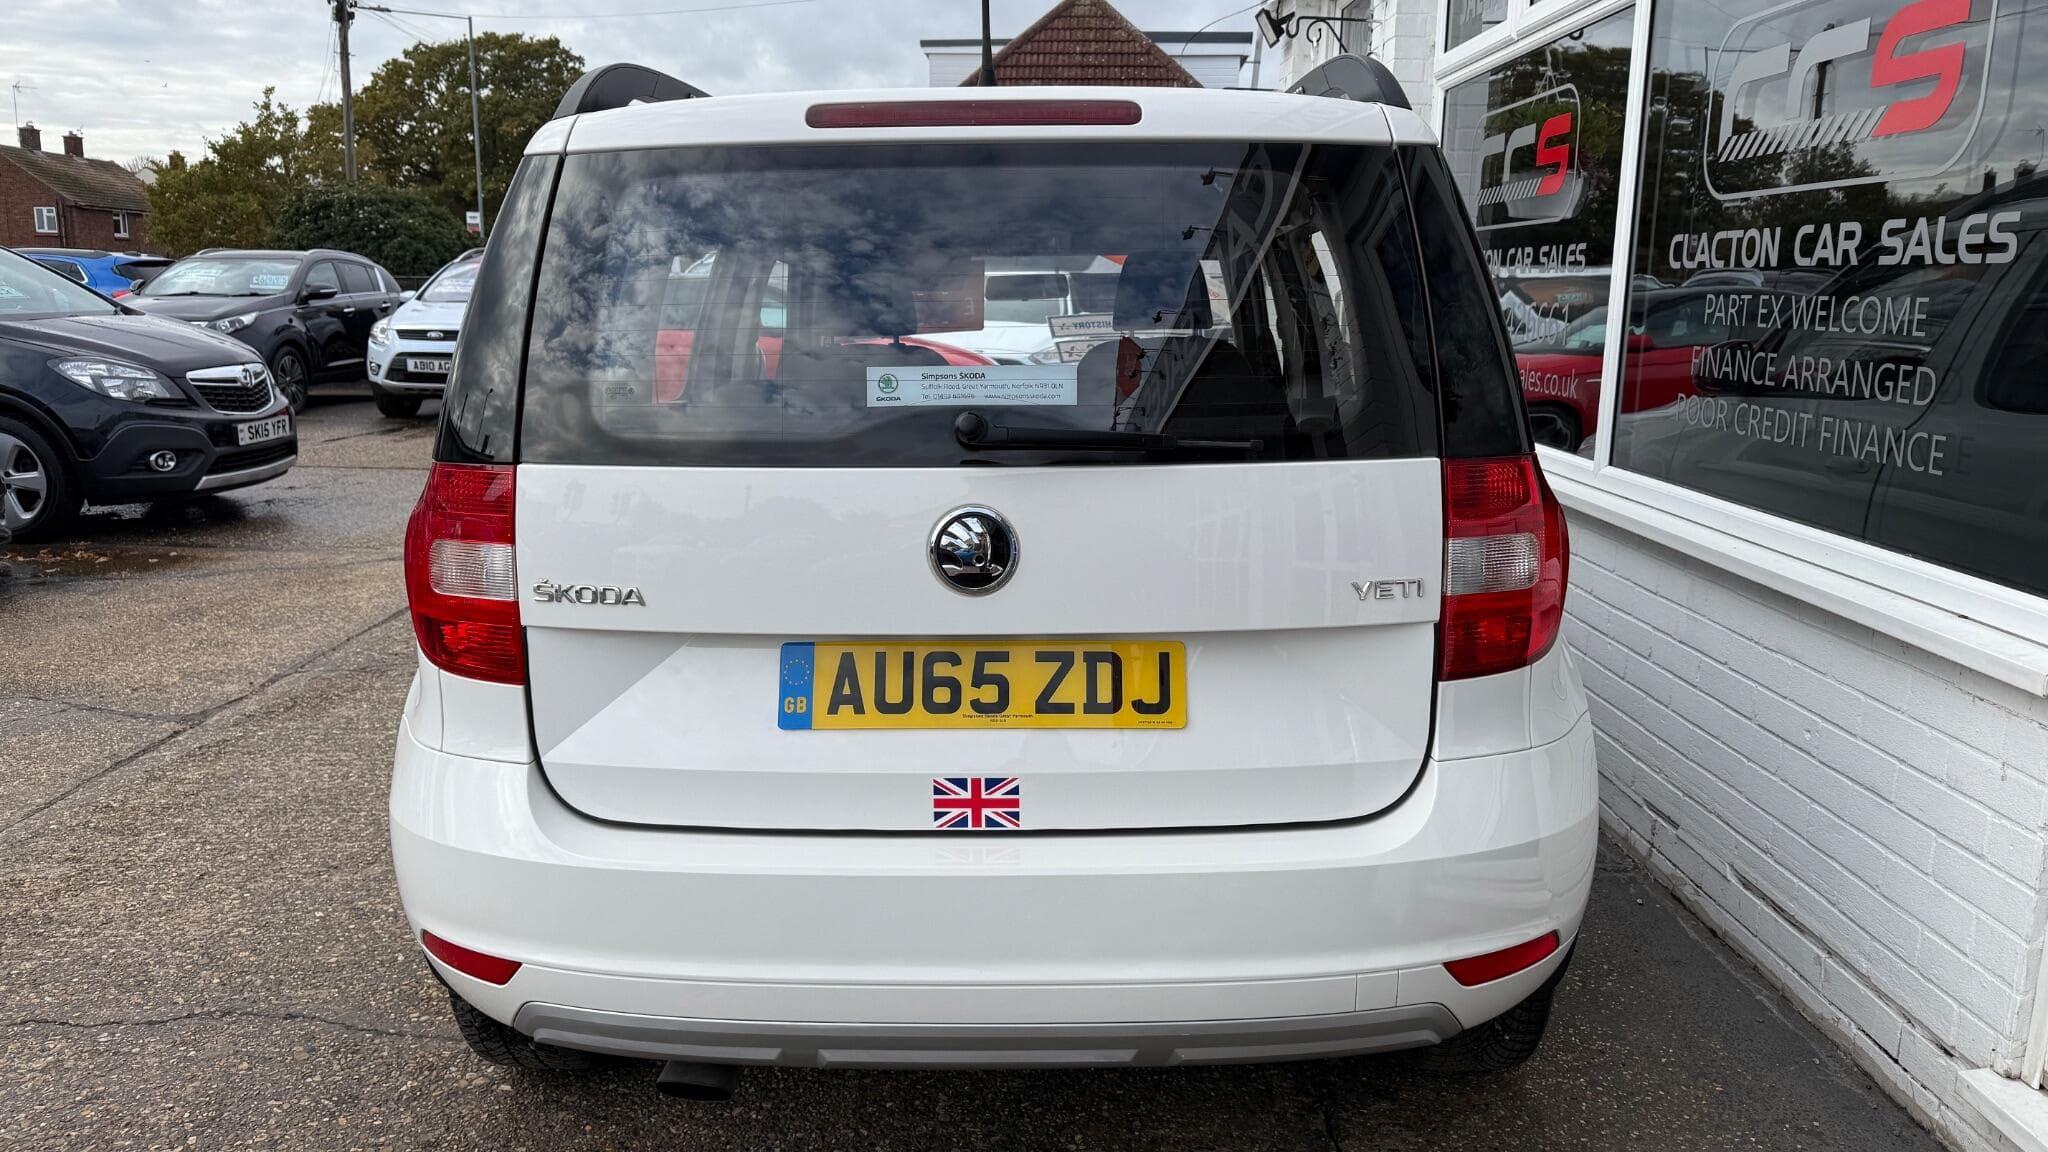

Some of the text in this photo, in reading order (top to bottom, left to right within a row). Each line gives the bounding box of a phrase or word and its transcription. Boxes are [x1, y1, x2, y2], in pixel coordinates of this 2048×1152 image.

[1669, 211, 2022, 269] CLACTON CAR SALES
[1506, 246, 1534, 274] CAR
[1539, 242, 1588, 274] SALES
[1704, 294, 1930, 337] PART EX WELCOME
[921, 373, 958, 381] Simpsons
[1691, 346, 1937, 406] FINANCE ARRANGED
[247, 418, 287, 440] SK15 YFR
[1674, 393, 1947, 476] POOR CREDIT FINANCE
[532, 577, 646, 606] ŠKODA
[1350, 578, 1424, 600] YETI
[826, 651, 1172, 715] AU65 ZDJ
[783, 696, 807, 714] GB
